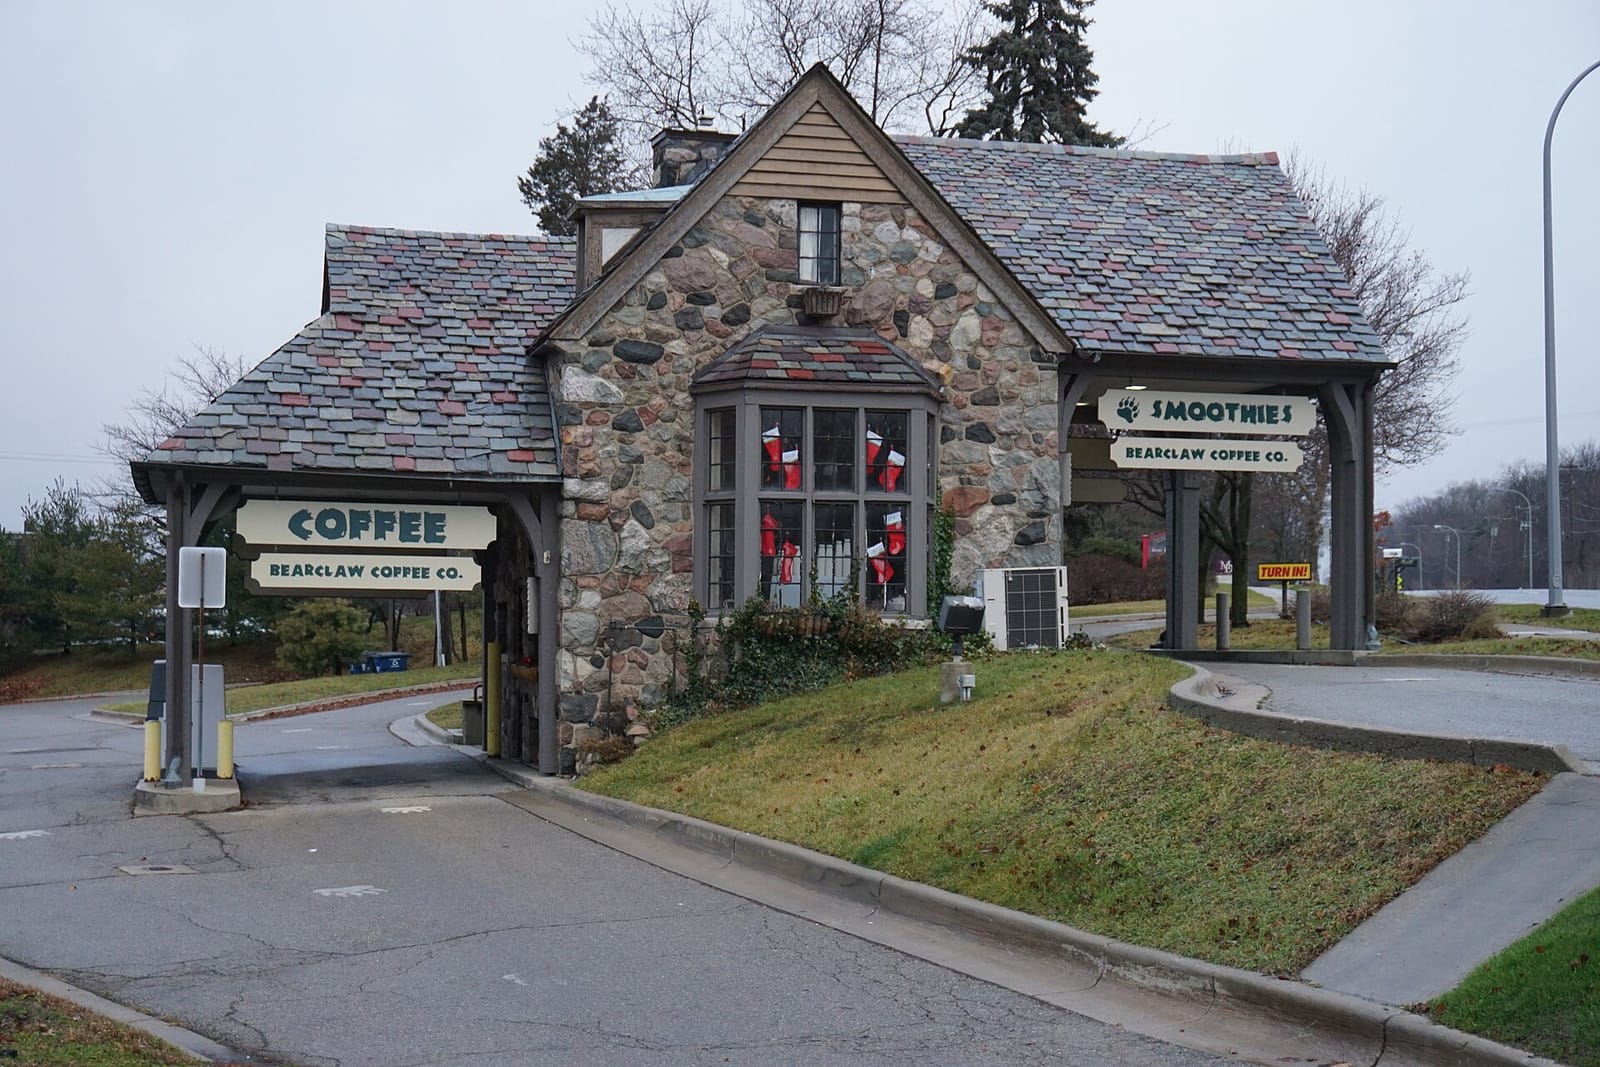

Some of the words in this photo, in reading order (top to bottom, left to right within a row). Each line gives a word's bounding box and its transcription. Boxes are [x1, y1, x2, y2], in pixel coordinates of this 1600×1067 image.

[1151, 399, 1293, 425] SMOOTHIES
[1126, 447, 1205, 460] BEARCLAW
[1210, 449, 1260, 461] COFFEE
[1265, 451, 1288, 462] CO.
[288, 507, 447, 544] COFFEE
[270, 563, 365, 579] BEARCLAW
[371, 565, 430, 579] COFFEE
[436, 567, 463, 580] CO.
[1261, 566, 1290, 577] TURN
[1292, 565, 1308, 577] IN!
